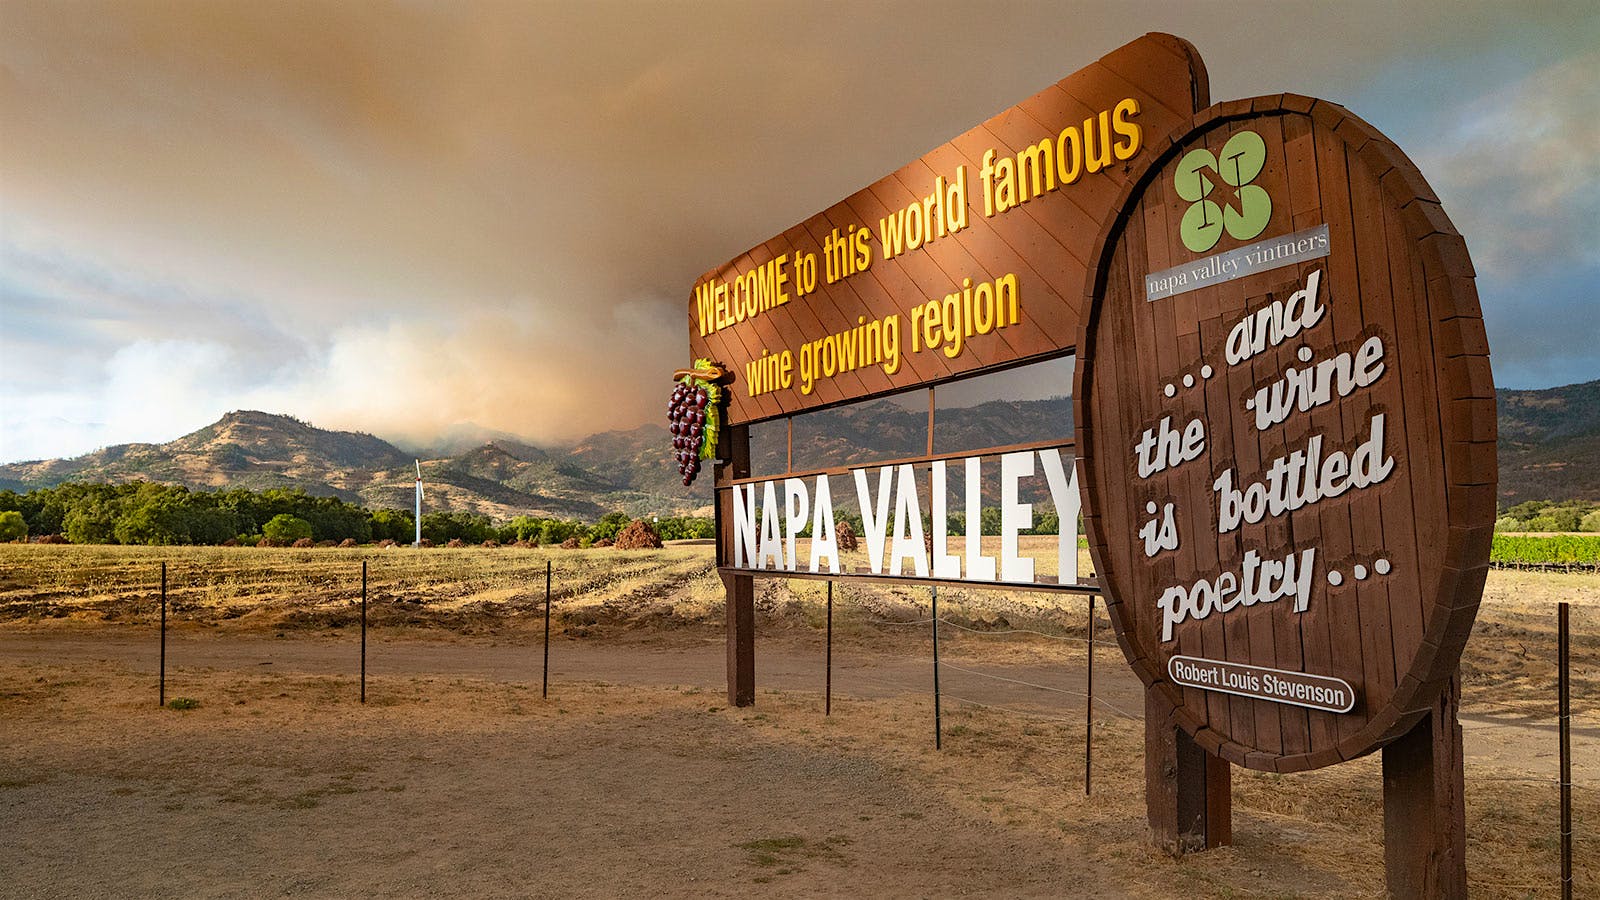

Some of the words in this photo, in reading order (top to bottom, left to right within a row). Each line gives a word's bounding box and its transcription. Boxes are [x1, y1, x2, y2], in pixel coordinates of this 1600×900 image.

[696, 253, 789, 338] WELCOME
[794, 249, 817, 298] to
[823, 223, 872, 286] this
[880, 165, 969, 260] world
[980, 97, 1143, 218] famous
[1149, 272, 1187, 295] napa
[1191, 256, 1241, 281] valley
[1243, 233, 1328, 267] vintners
[746, 345, 792, 398] wine
[800, 312, 901, 396] growing
[910, 272, 1020, 359] region
[1135, 416, 1206, 480] the
[1246, 336, 1386, 431] wine
[732, 474, 840, 574] NAPA
[854, 449, 1082, 585] VALLEY
[1139, 500, 1179, 558] is
[1213, 413, 1395, 534] bottled
[1174, 661, 1219, 688] Robert
[1221, 672, 1260, 693] Louis
[1263, 674, 1346, 707] Stevenson
